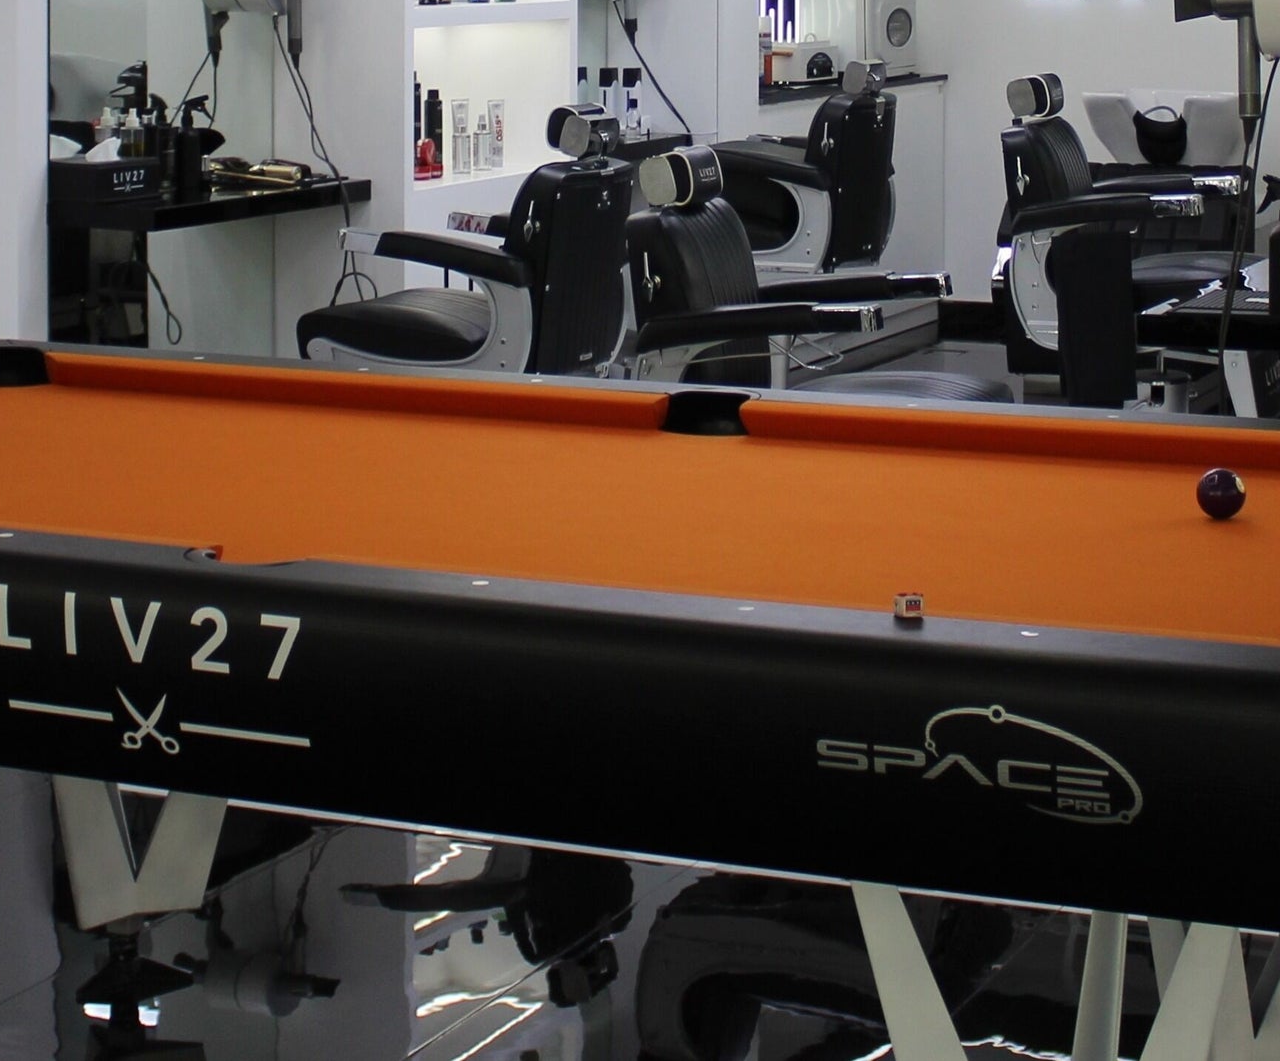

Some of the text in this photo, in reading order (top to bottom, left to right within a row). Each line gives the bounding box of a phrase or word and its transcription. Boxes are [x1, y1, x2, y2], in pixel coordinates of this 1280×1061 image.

[113, 169, 145, 184] LIV27
[816, 738, 1111, 799] SPACE
[1057, 797, 1111, 814] PRO
